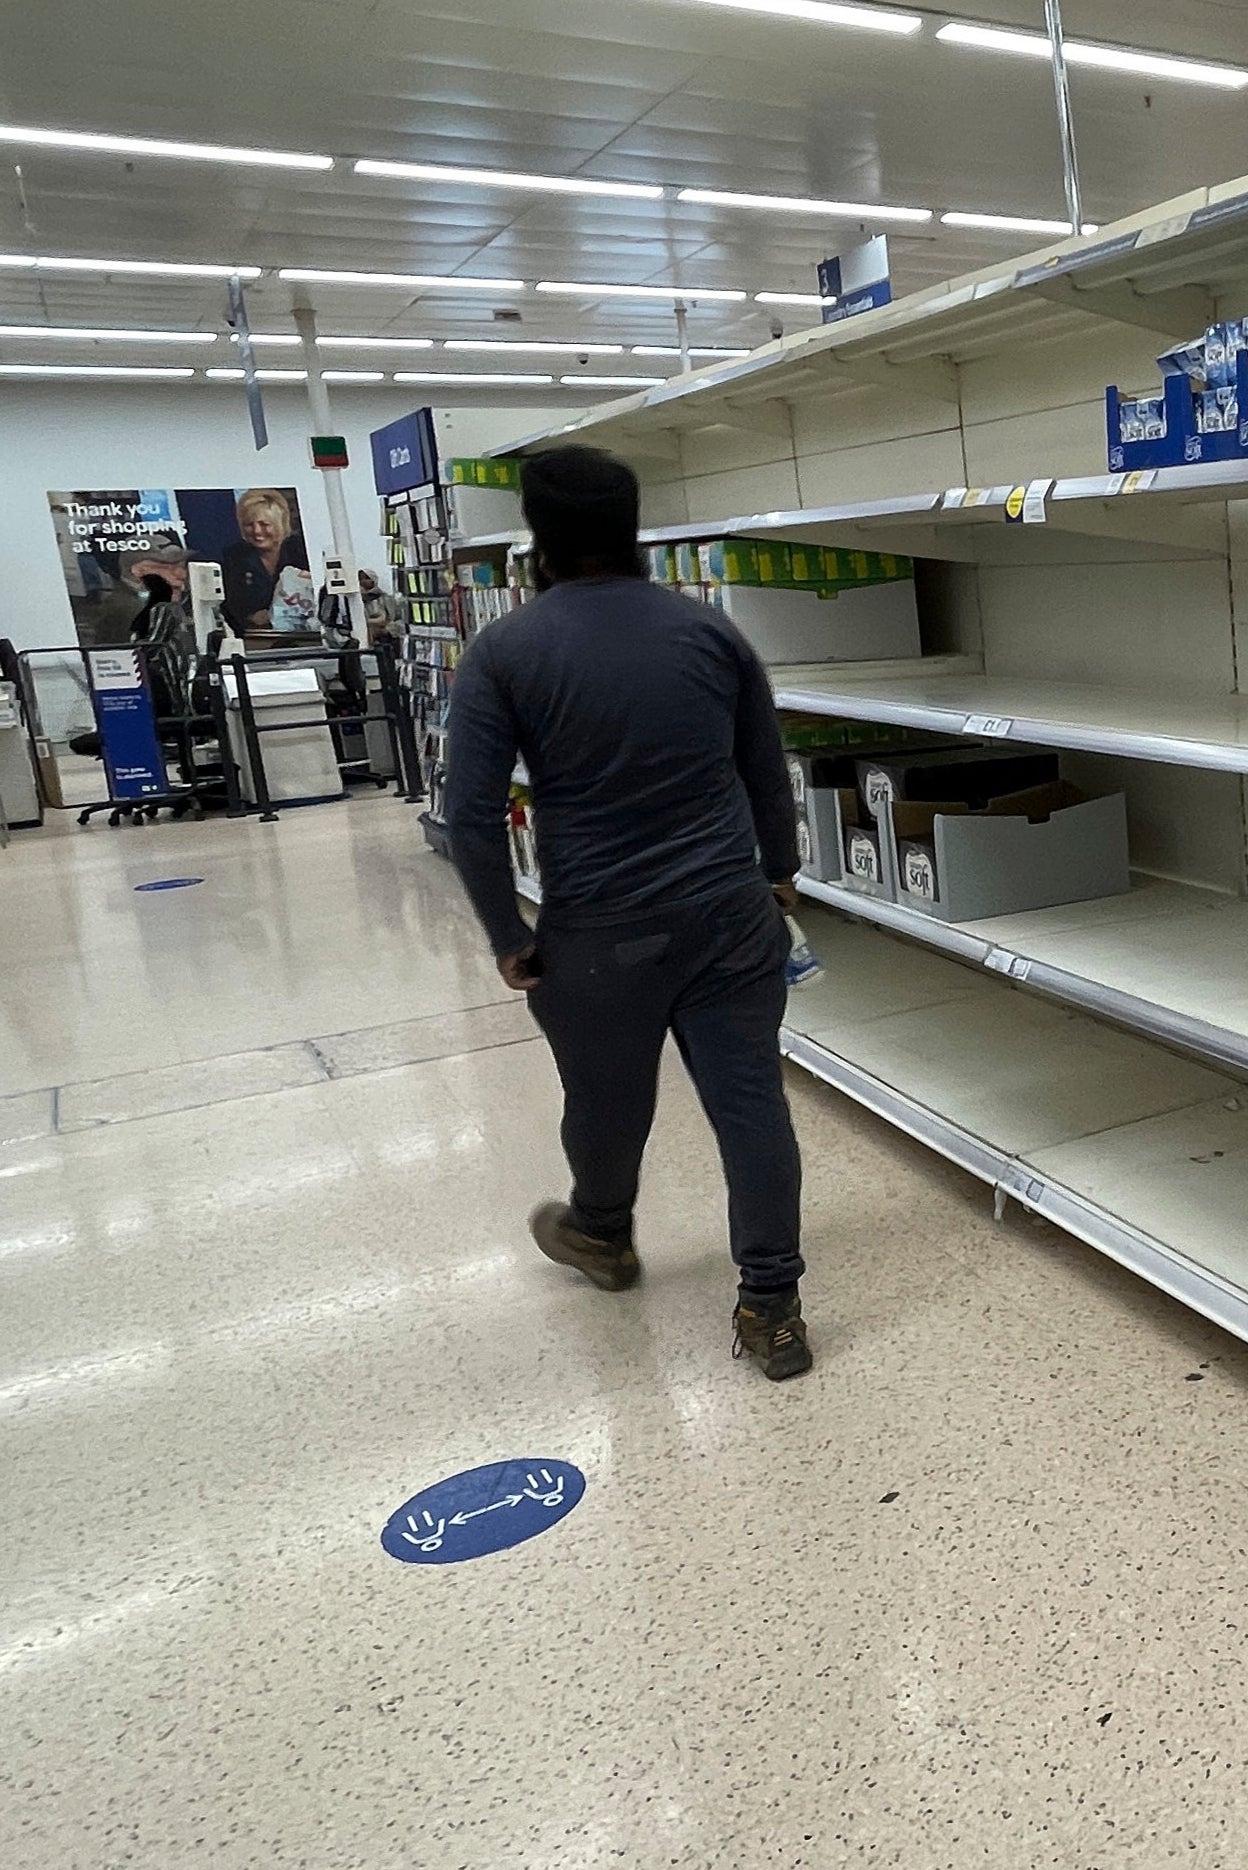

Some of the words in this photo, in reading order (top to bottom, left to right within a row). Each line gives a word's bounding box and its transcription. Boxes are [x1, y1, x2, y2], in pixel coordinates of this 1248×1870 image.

[63, 501, 123, 517] Thank
[126, 503, 160, 518] you
[68, 520, 98, 536] for
[102, 518, 188, 537] shopping
[72, 540, 93, 554] at
[95, 537, 151, 552] Tesco
[910, 863, 931, 897] soft
